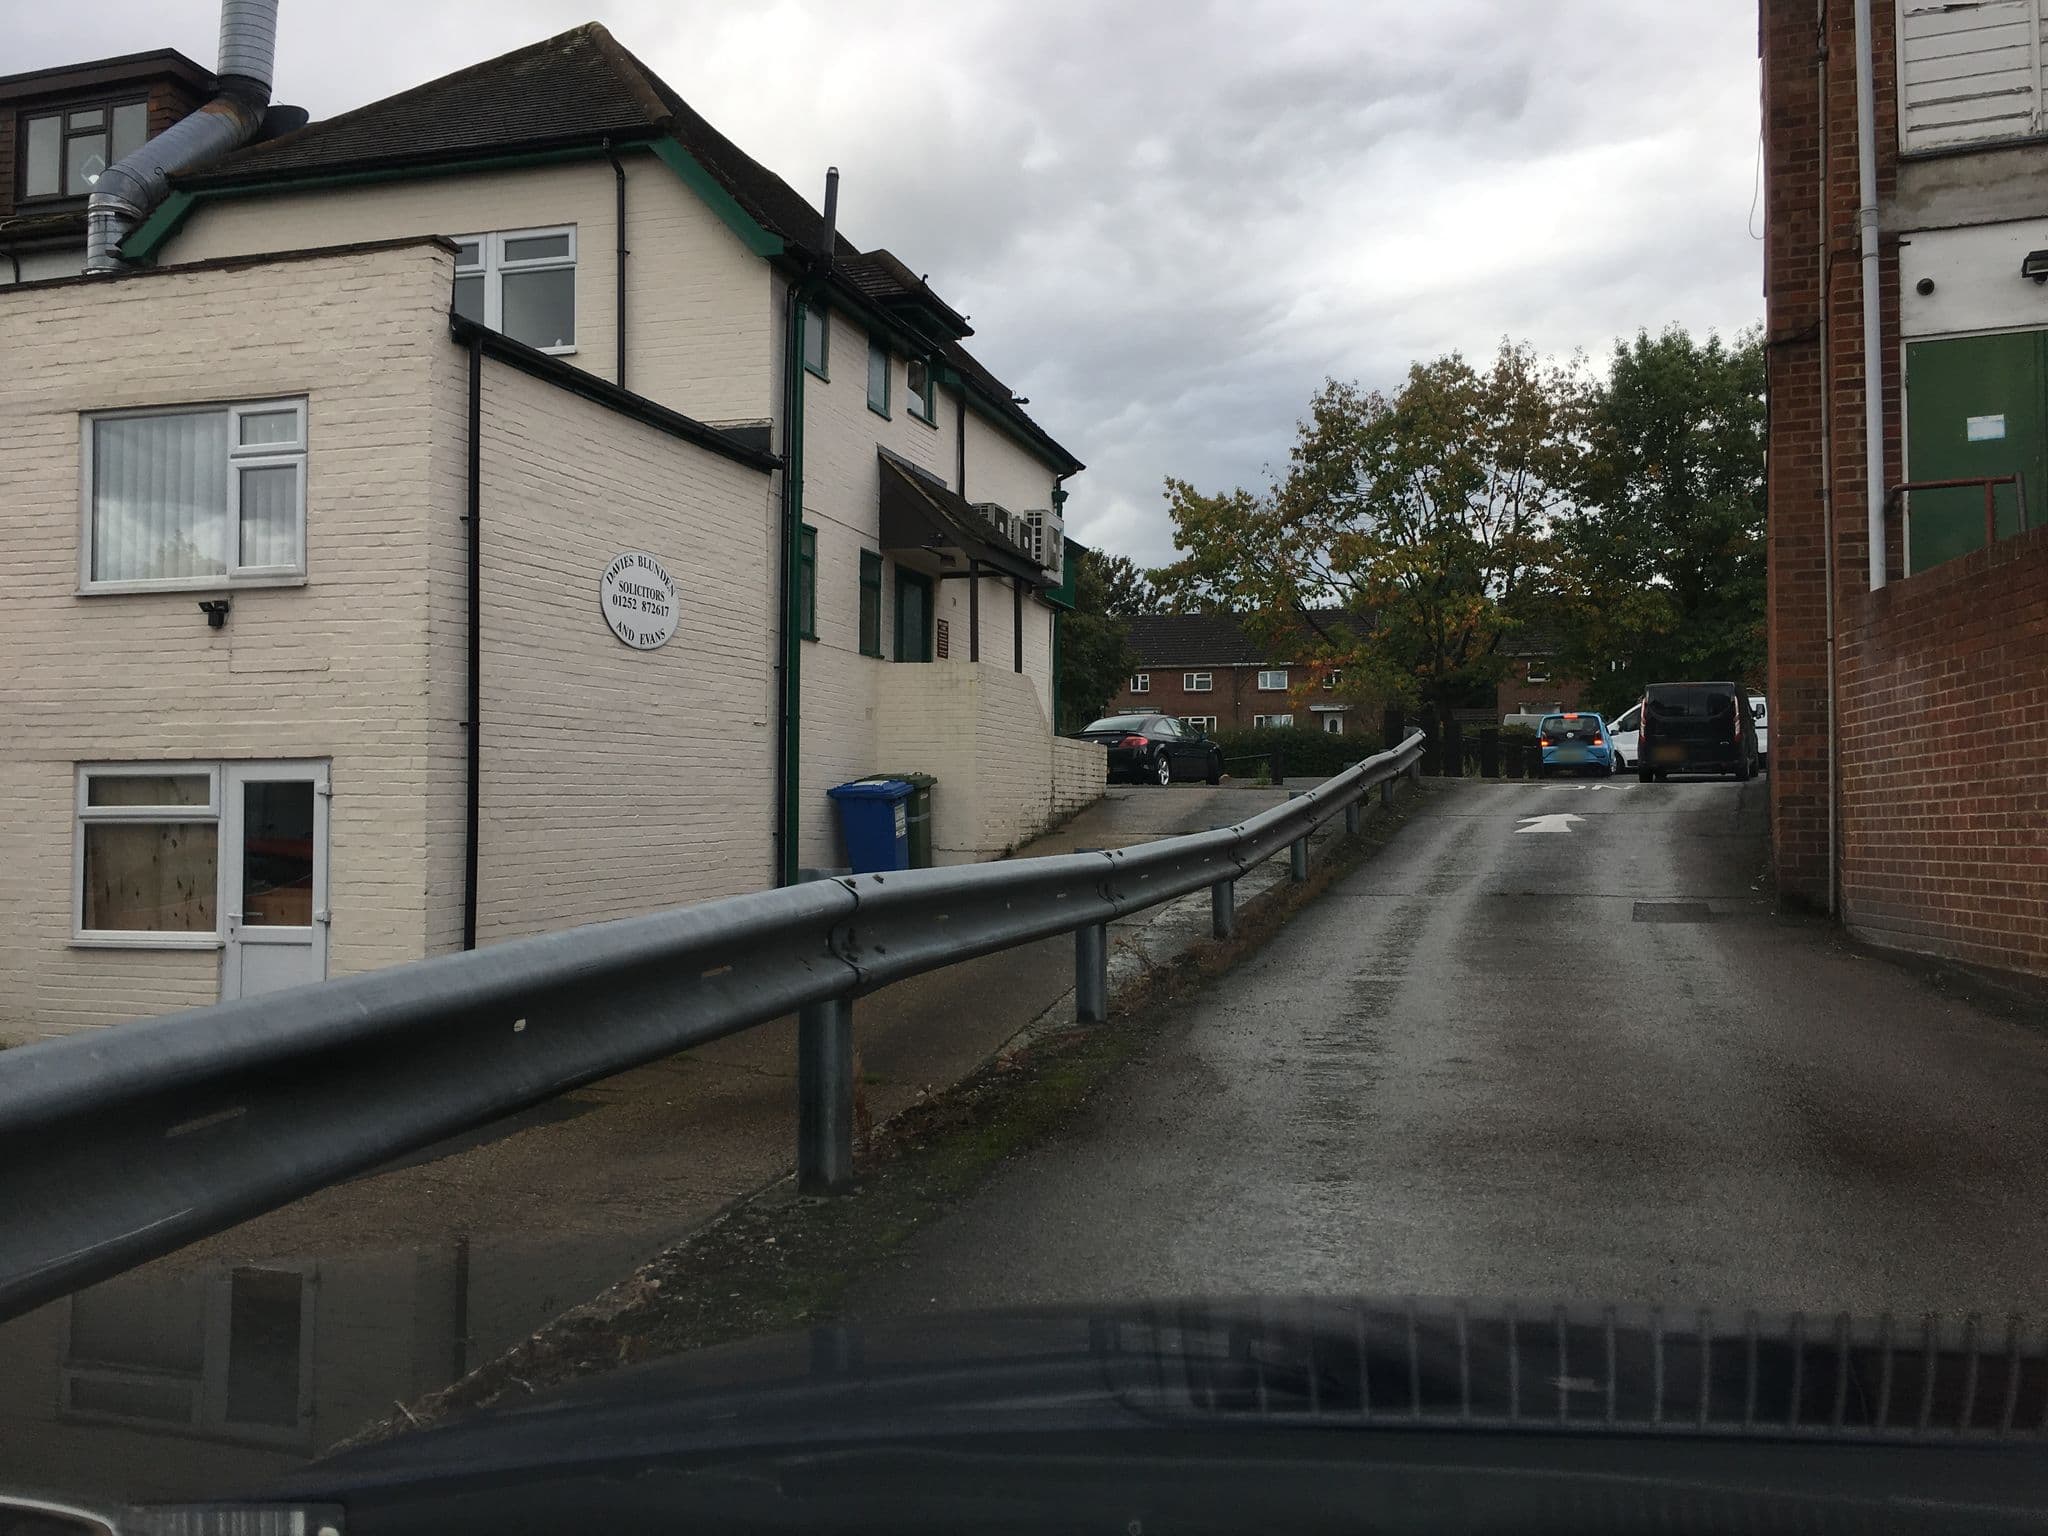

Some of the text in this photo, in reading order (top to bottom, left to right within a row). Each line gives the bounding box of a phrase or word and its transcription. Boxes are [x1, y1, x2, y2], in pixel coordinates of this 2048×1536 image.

[606, 555, 674, 597] DAVIES BLUNDEN
[618, 581, 665, 602] SOLICITORS
[612, 594, 669, 617] 01252 872617
[616, 621, 665, 645] AND EVANS
